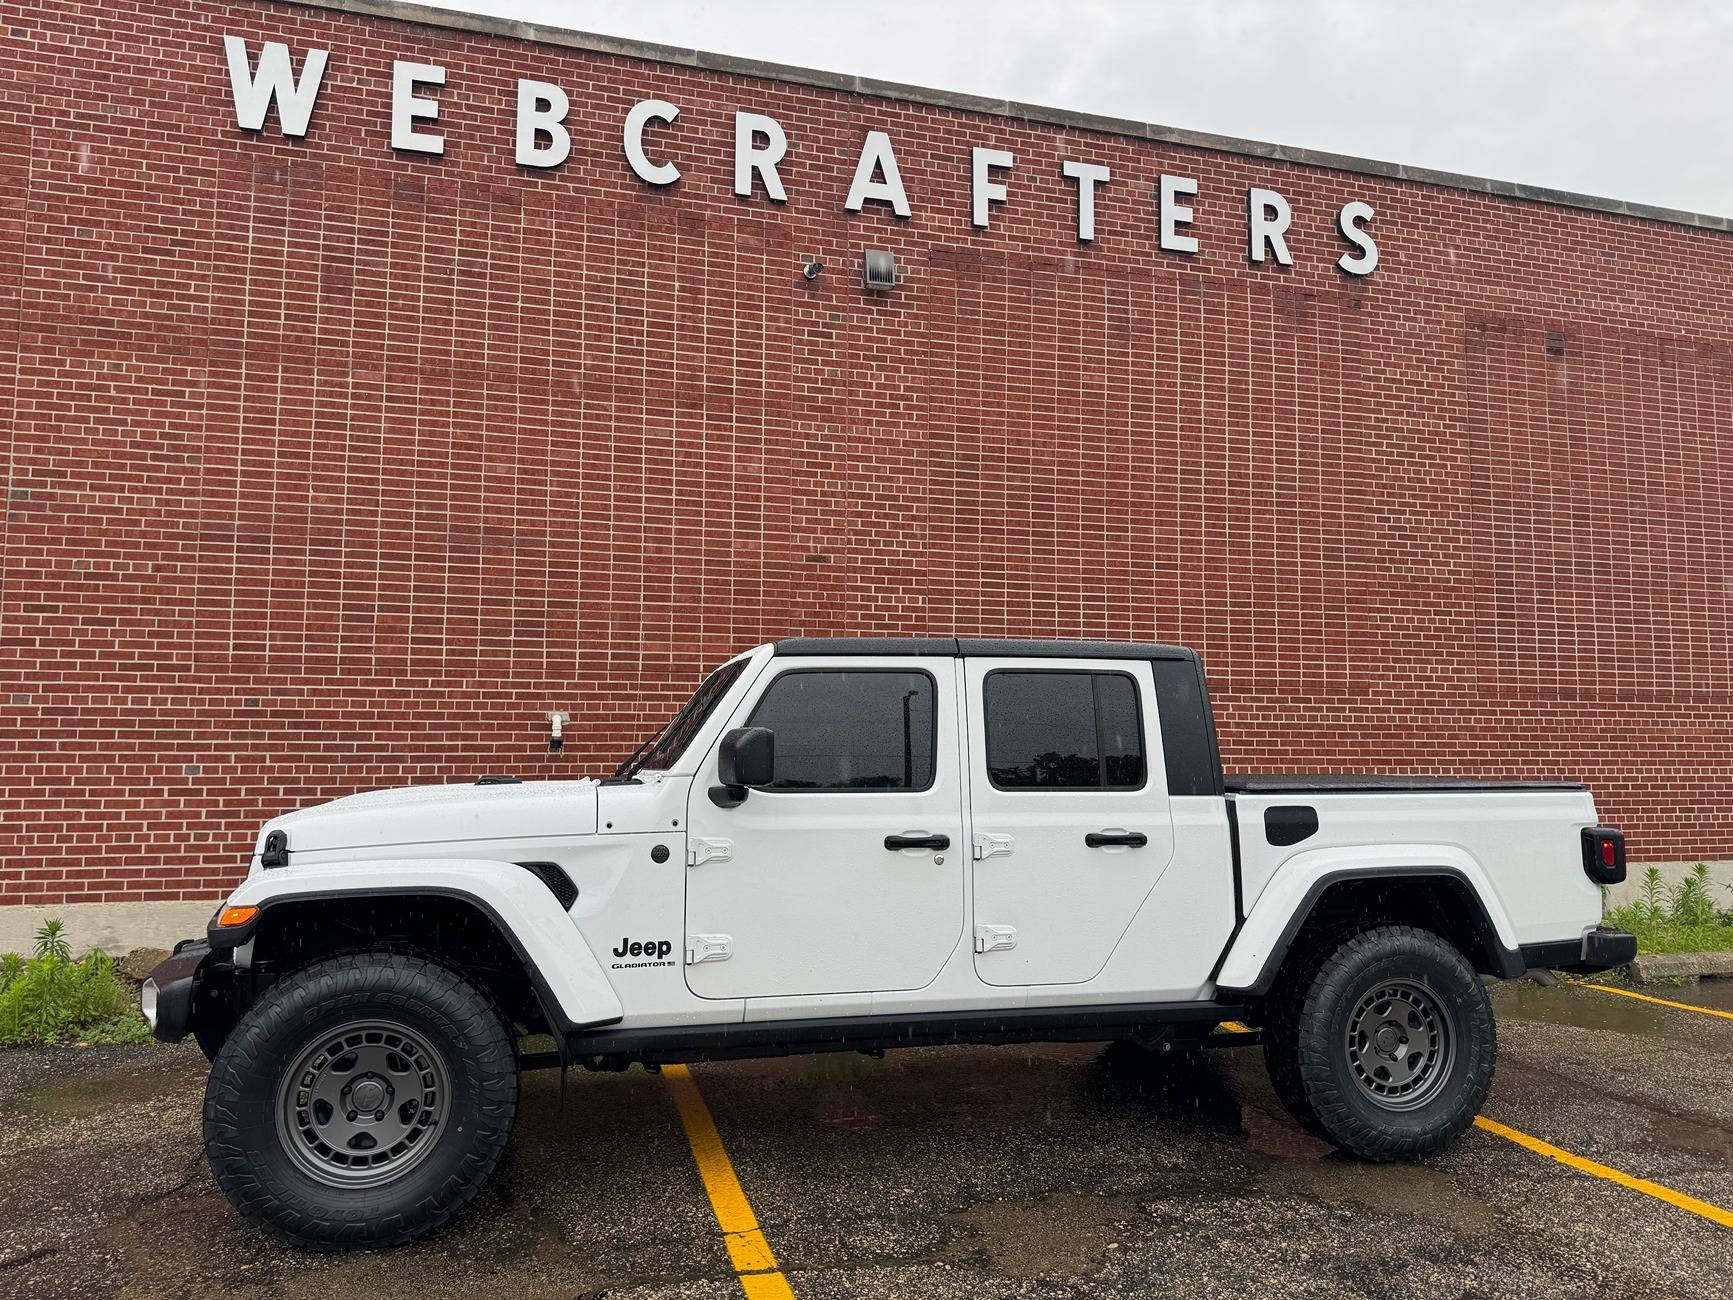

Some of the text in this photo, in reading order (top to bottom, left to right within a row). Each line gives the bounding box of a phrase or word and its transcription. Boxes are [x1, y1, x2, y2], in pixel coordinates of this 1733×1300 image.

[224, 35, 1379, 275] WEBCRAFTERS
[611, 961, 666, 970] GLADIATOR
[612, 937, 672, 960] Jeep
[374, 992, 469, 1050] COUNTRY
